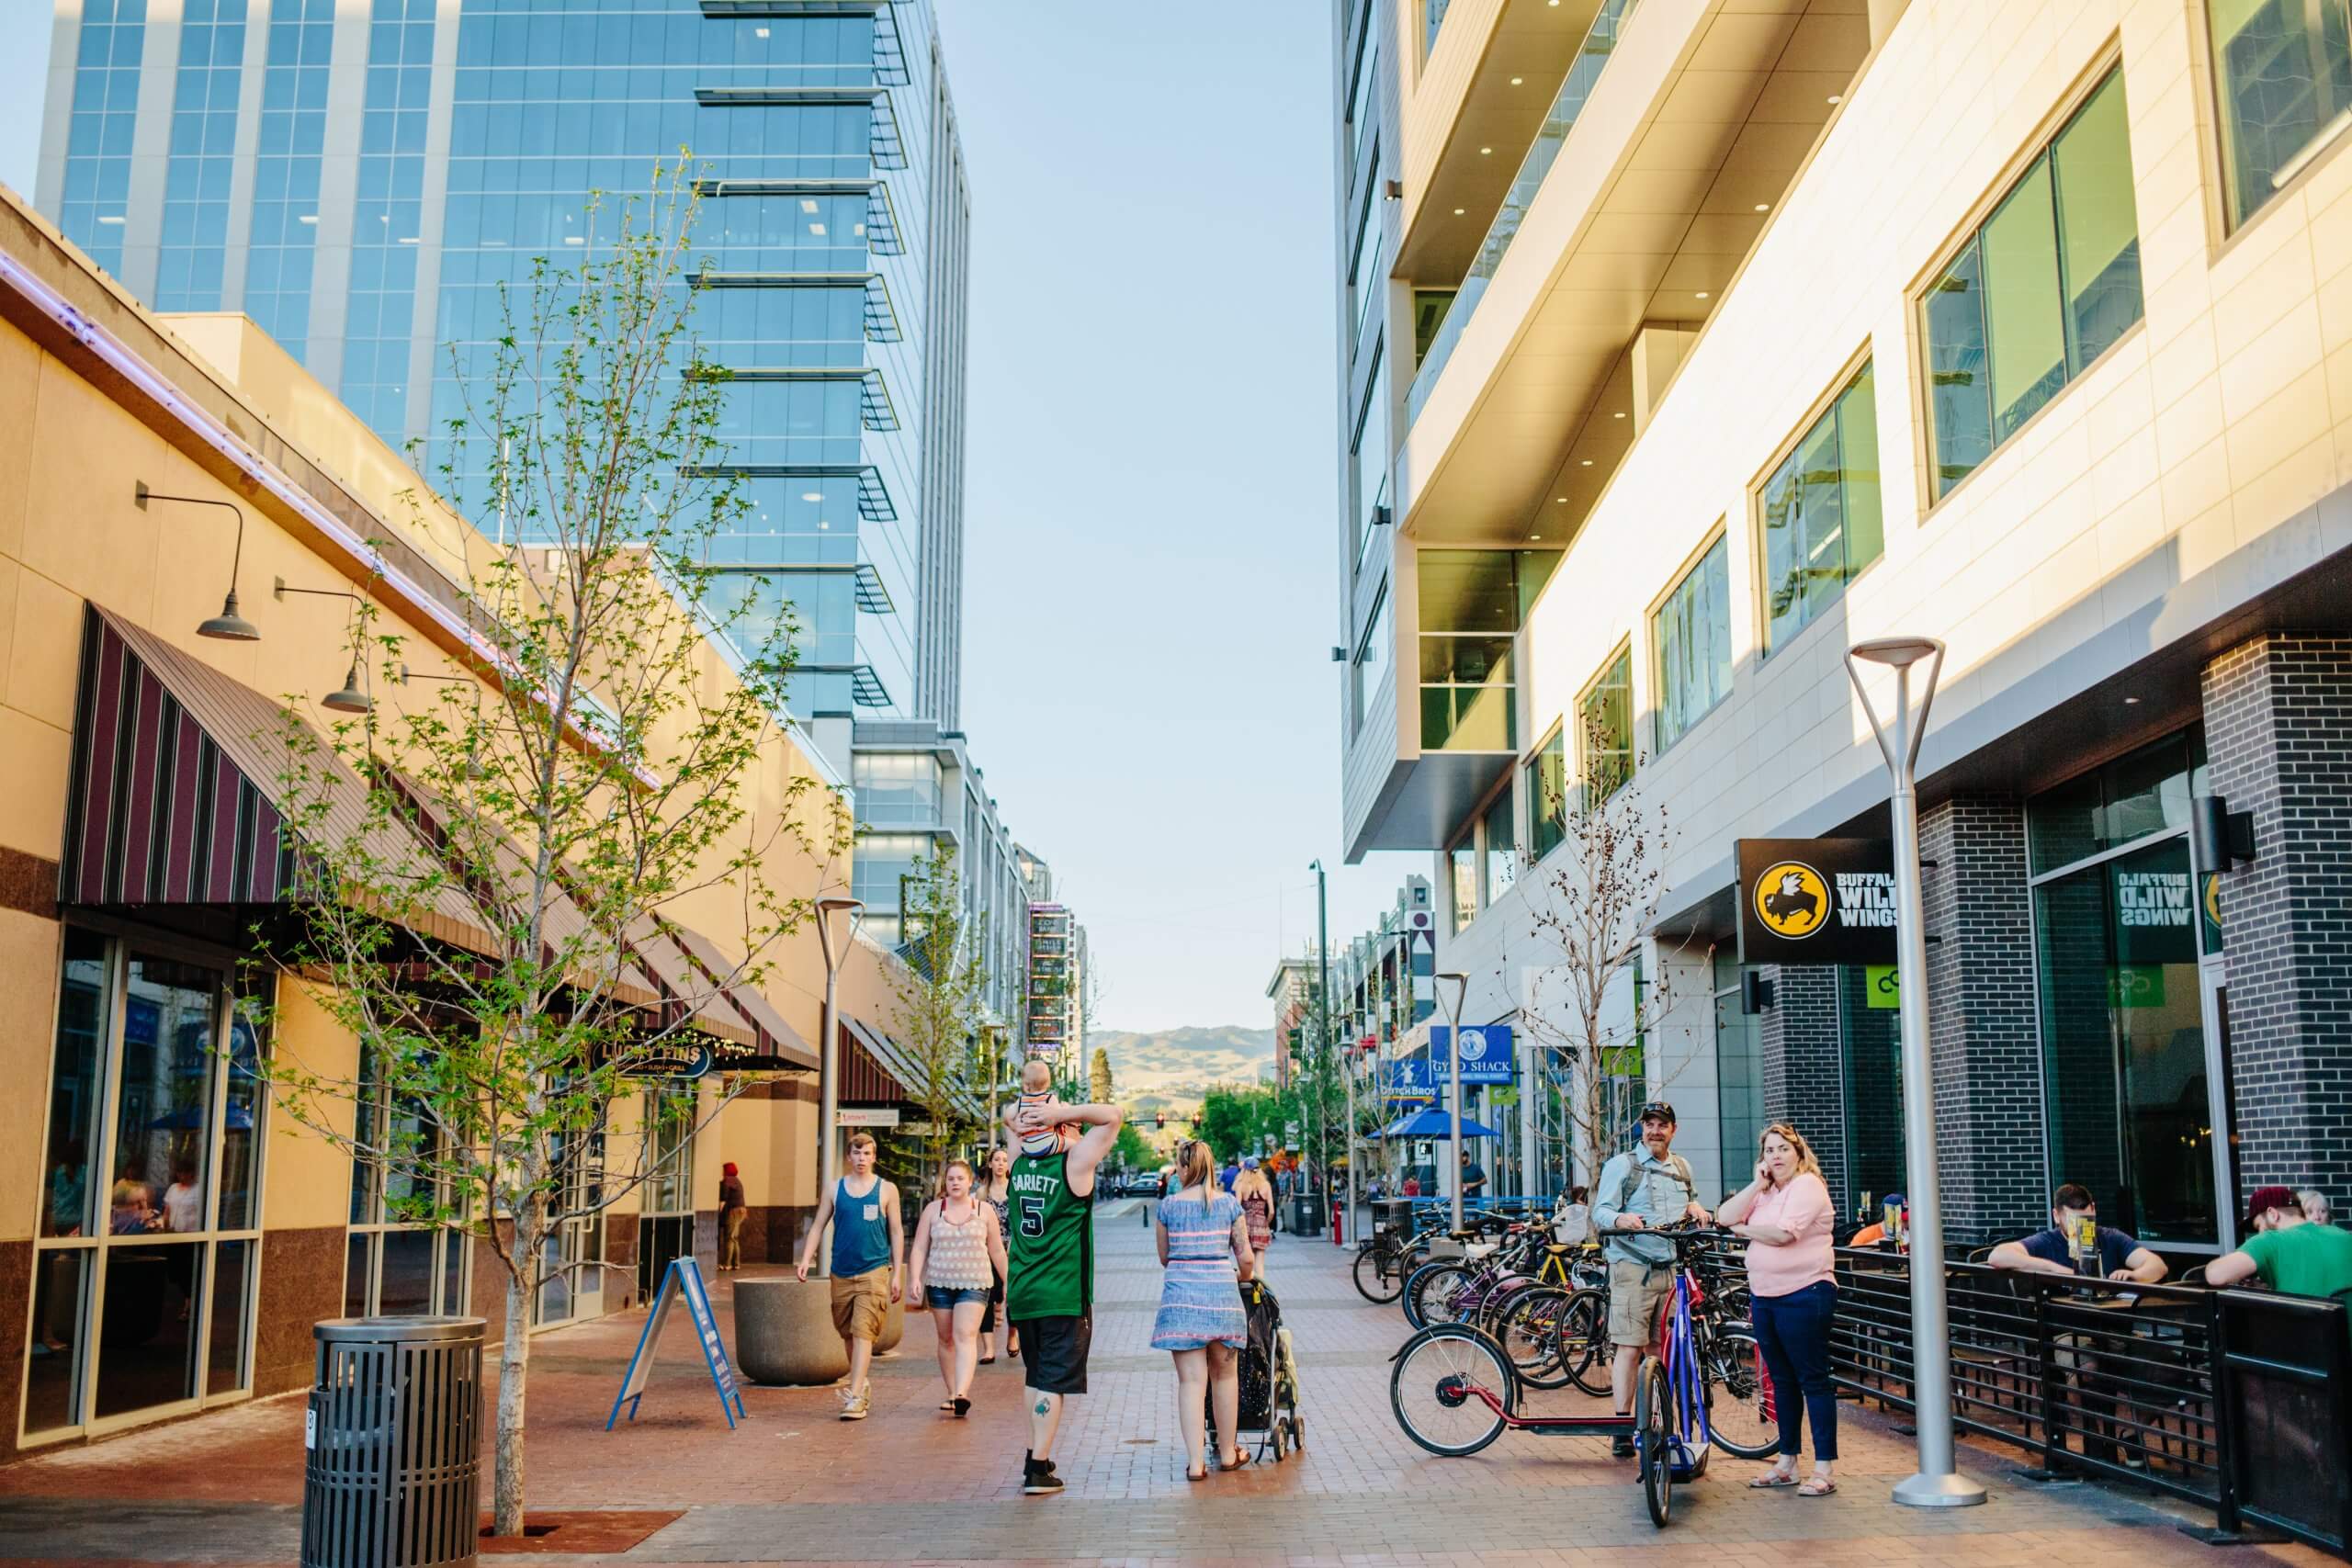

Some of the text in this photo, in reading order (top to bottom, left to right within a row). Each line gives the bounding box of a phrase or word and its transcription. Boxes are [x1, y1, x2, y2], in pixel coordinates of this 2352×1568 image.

[1836, 873, 1896, 886] BUFFAL
[1432, 1060, 1511, 1072] GYO SHACK
[1020, 1196, 1045, 1237] 5
